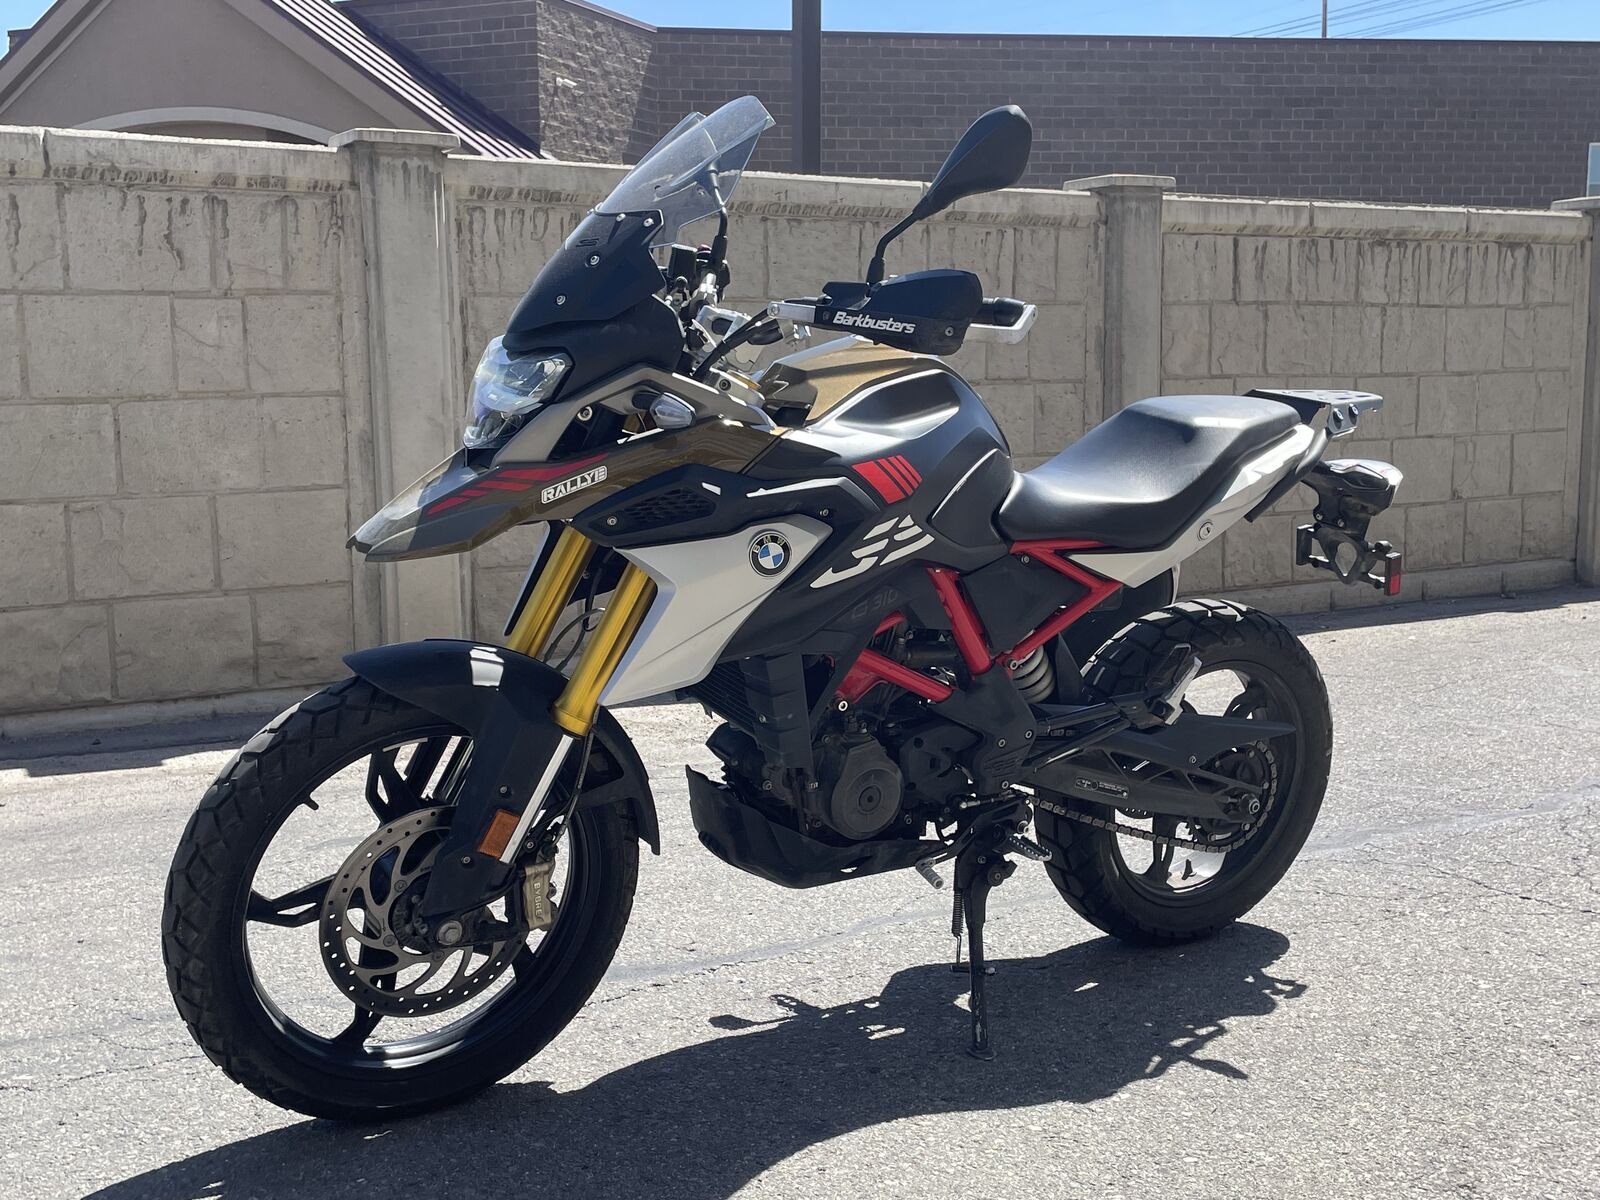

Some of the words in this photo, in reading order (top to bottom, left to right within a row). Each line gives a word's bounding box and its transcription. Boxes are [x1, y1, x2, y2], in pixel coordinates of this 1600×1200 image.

[832, 311, 916, 334] Barkbusters
[543, 467, 606, 502] RALLYE
[752, 534, 786, 554] BMW
